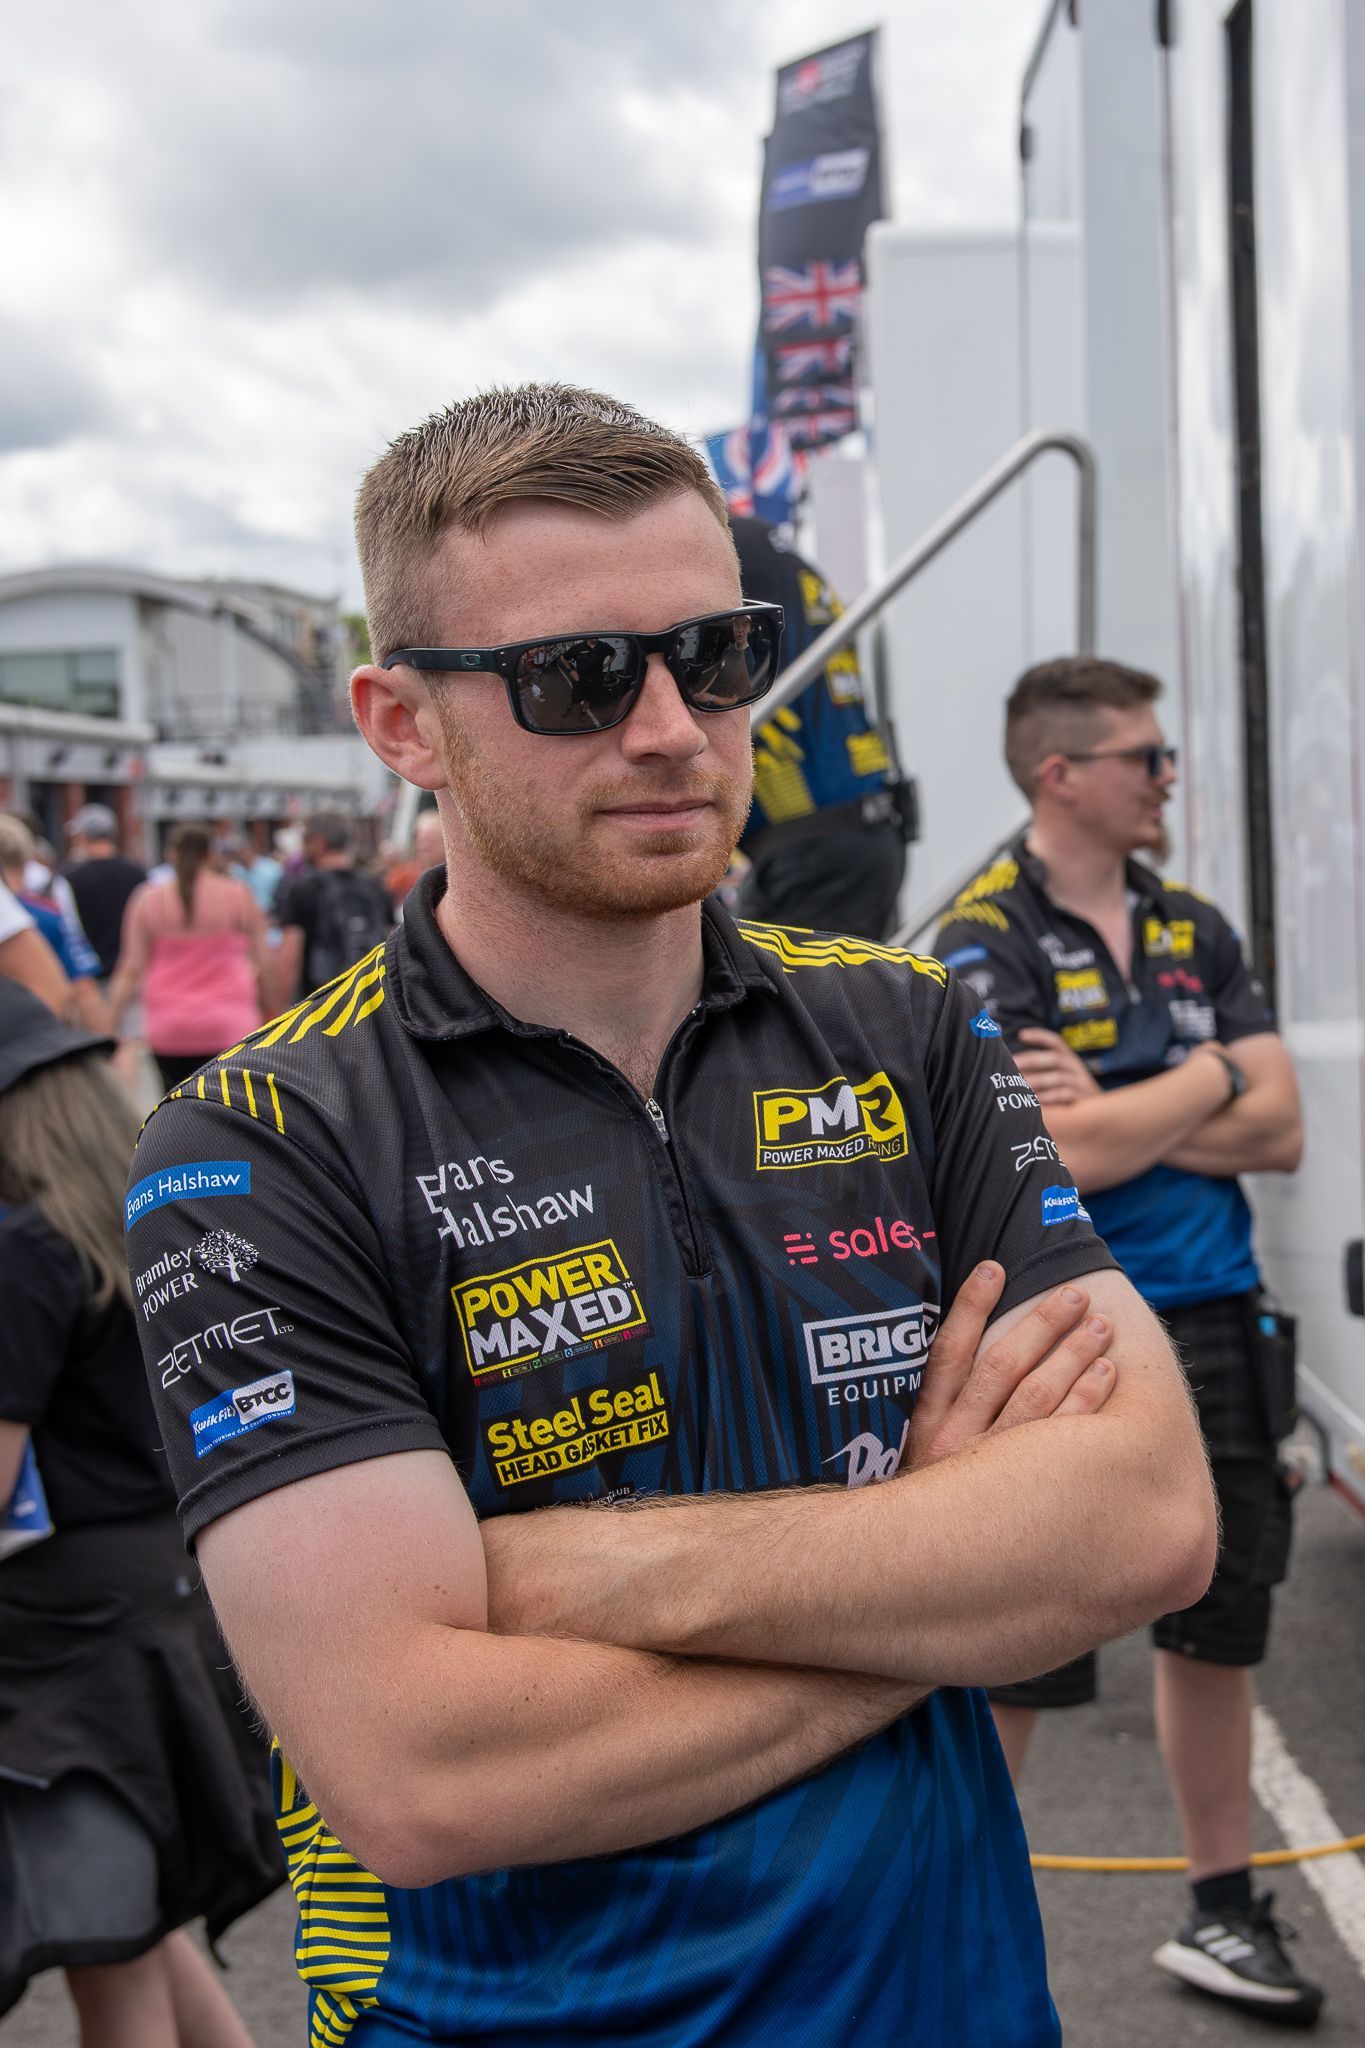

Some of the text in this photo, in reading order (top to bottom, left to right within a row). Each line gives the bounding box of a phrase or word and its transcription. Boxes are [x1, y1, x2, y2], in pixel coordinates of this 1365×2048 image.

[763, 1084, 897, 1141] PMR
[996, 1092, 1041, 1112] POWE
[763, 1149, 813, 1164] POWER
[817, 1138, 864, 1159] MAXED
[1010, 1135, 1066, 1172] ZET
[127, 1170, 241, 1221] Evans Halshaw
[135, 1247, 192, 1297] Bramley
[143, 1272, 200, 1322] POWER
[463, 1253, 619, 1328] POWER
[158, 1306, 281, 1389] ZETMET
[469, 1286, 632, 1366] MAXED
[235, 1382, 291, 1414] BTCC
[827, 1371, 922, 1406] EQUIPM
[237, 1425, 249, 1434] CAR
[487, 1372, 665, 1459] Steel Seal
[499, 1413, 667, 1483] HEAD GASKET FIX
